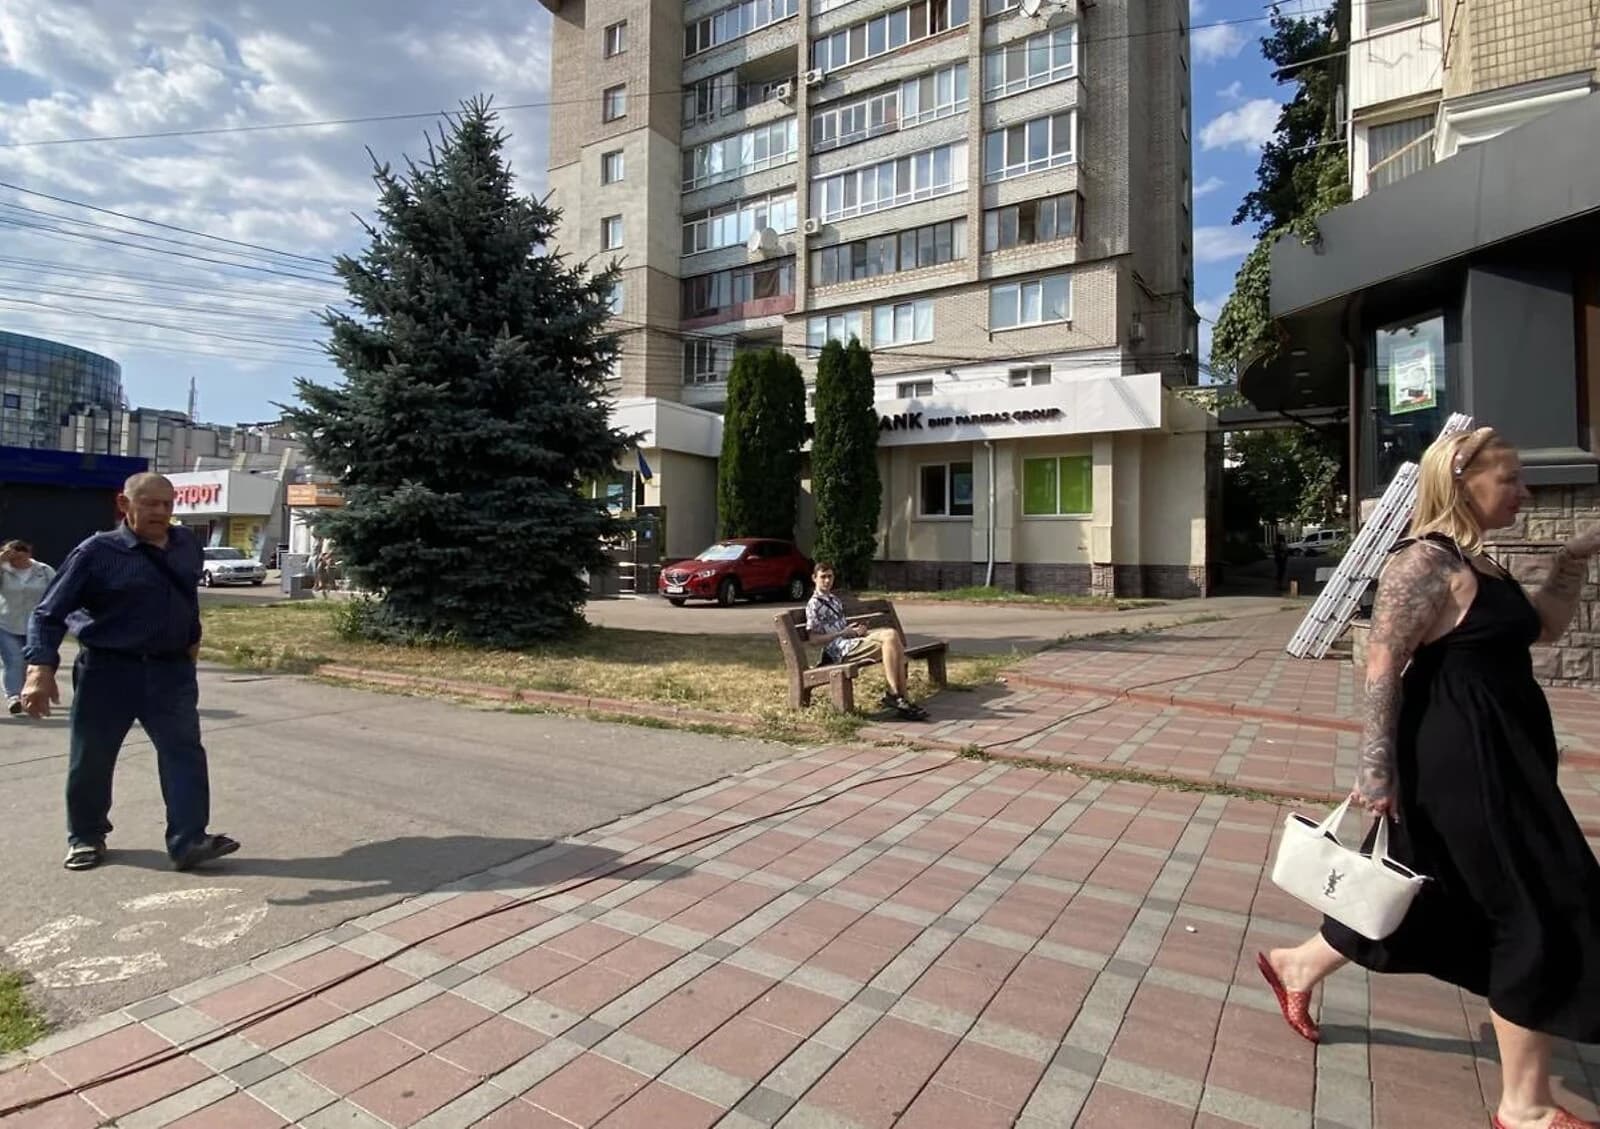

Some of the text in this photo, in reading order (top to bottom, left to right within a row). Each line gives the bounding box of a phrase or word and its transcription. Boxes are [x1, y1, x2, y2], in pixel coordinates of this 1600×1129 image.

[879, 412, 923, 431] ANK
[955, 411, 1010, 426] PARIBAS
[1012, 408, 1062, 421] GROUP
